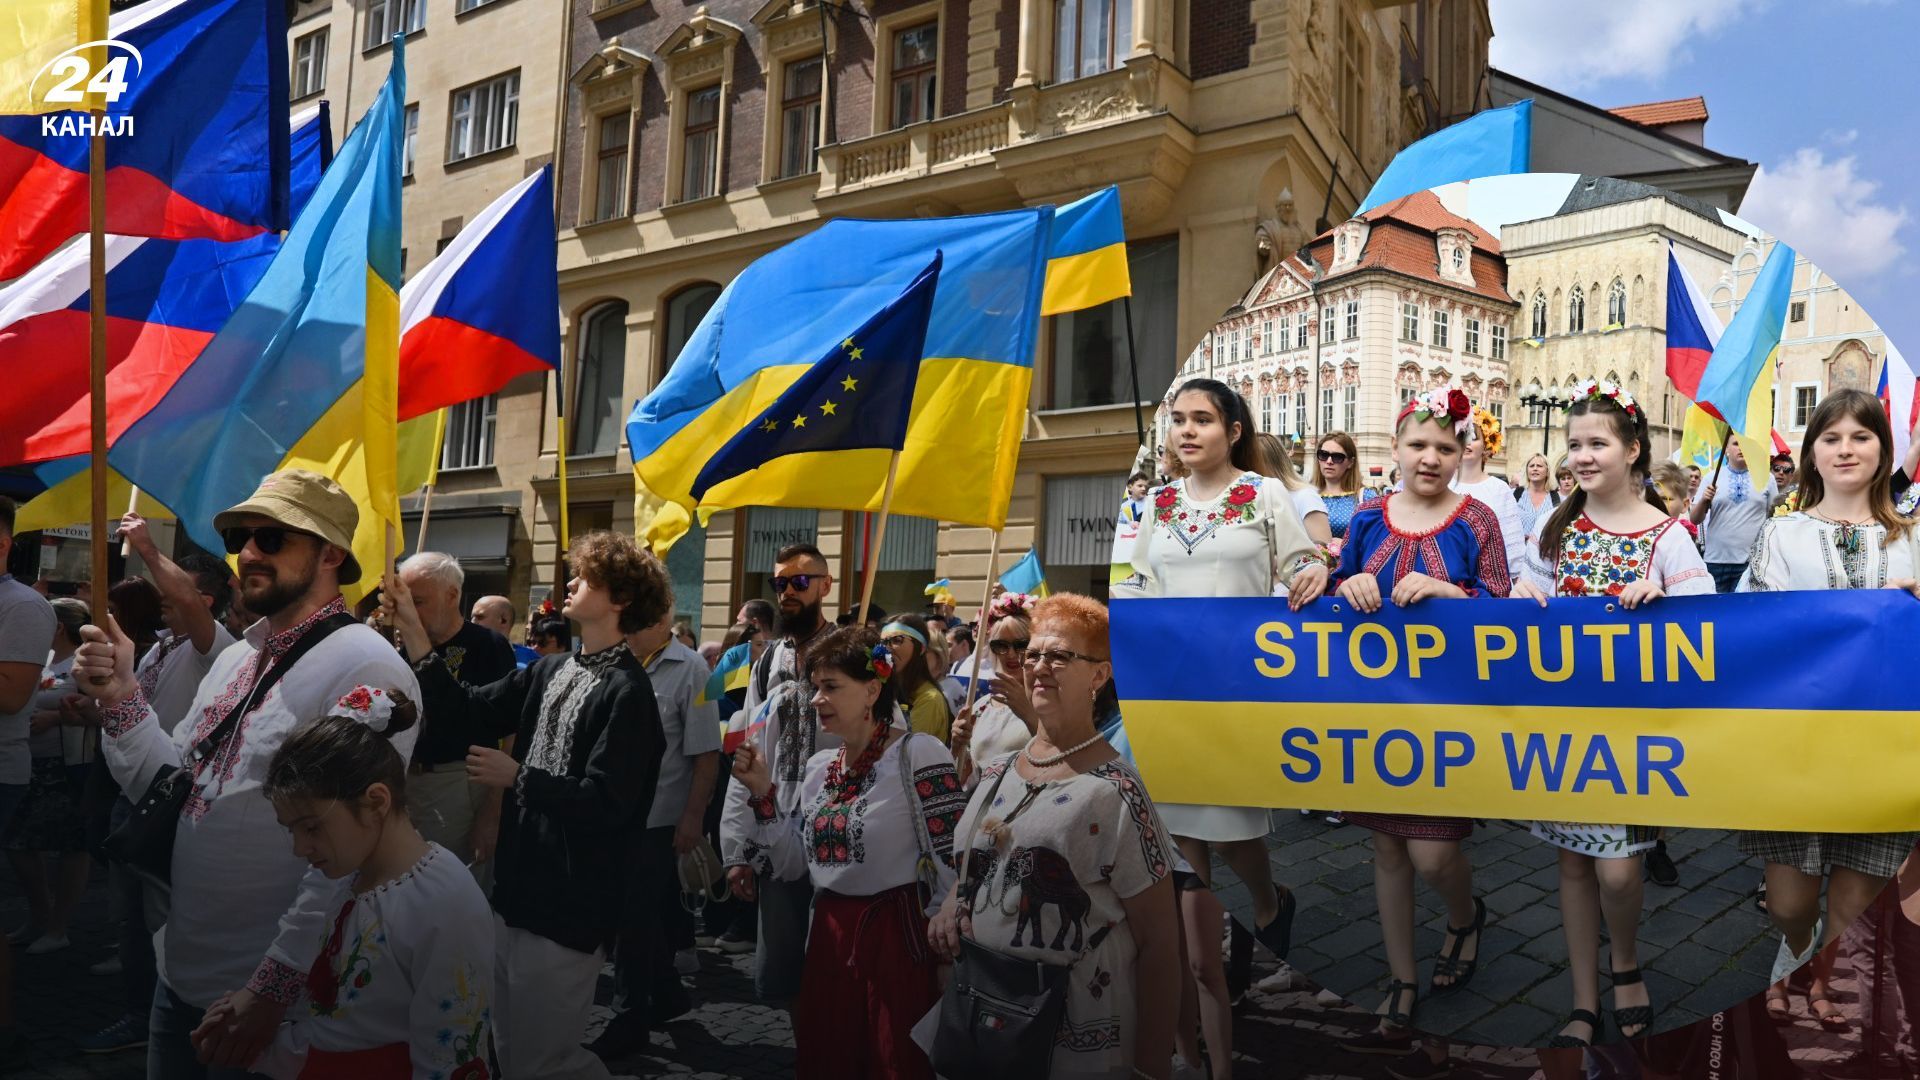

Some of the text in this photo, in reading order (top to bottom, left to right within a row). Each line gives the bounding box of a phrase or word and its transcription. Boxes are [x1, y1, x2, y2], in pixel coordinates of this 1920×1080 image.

[753, 528, 812, 544] TWINSET
[1254, 621, 1716, 683] STOP PUTIN
[1281, 727, 1690, 797] STOP WAR
